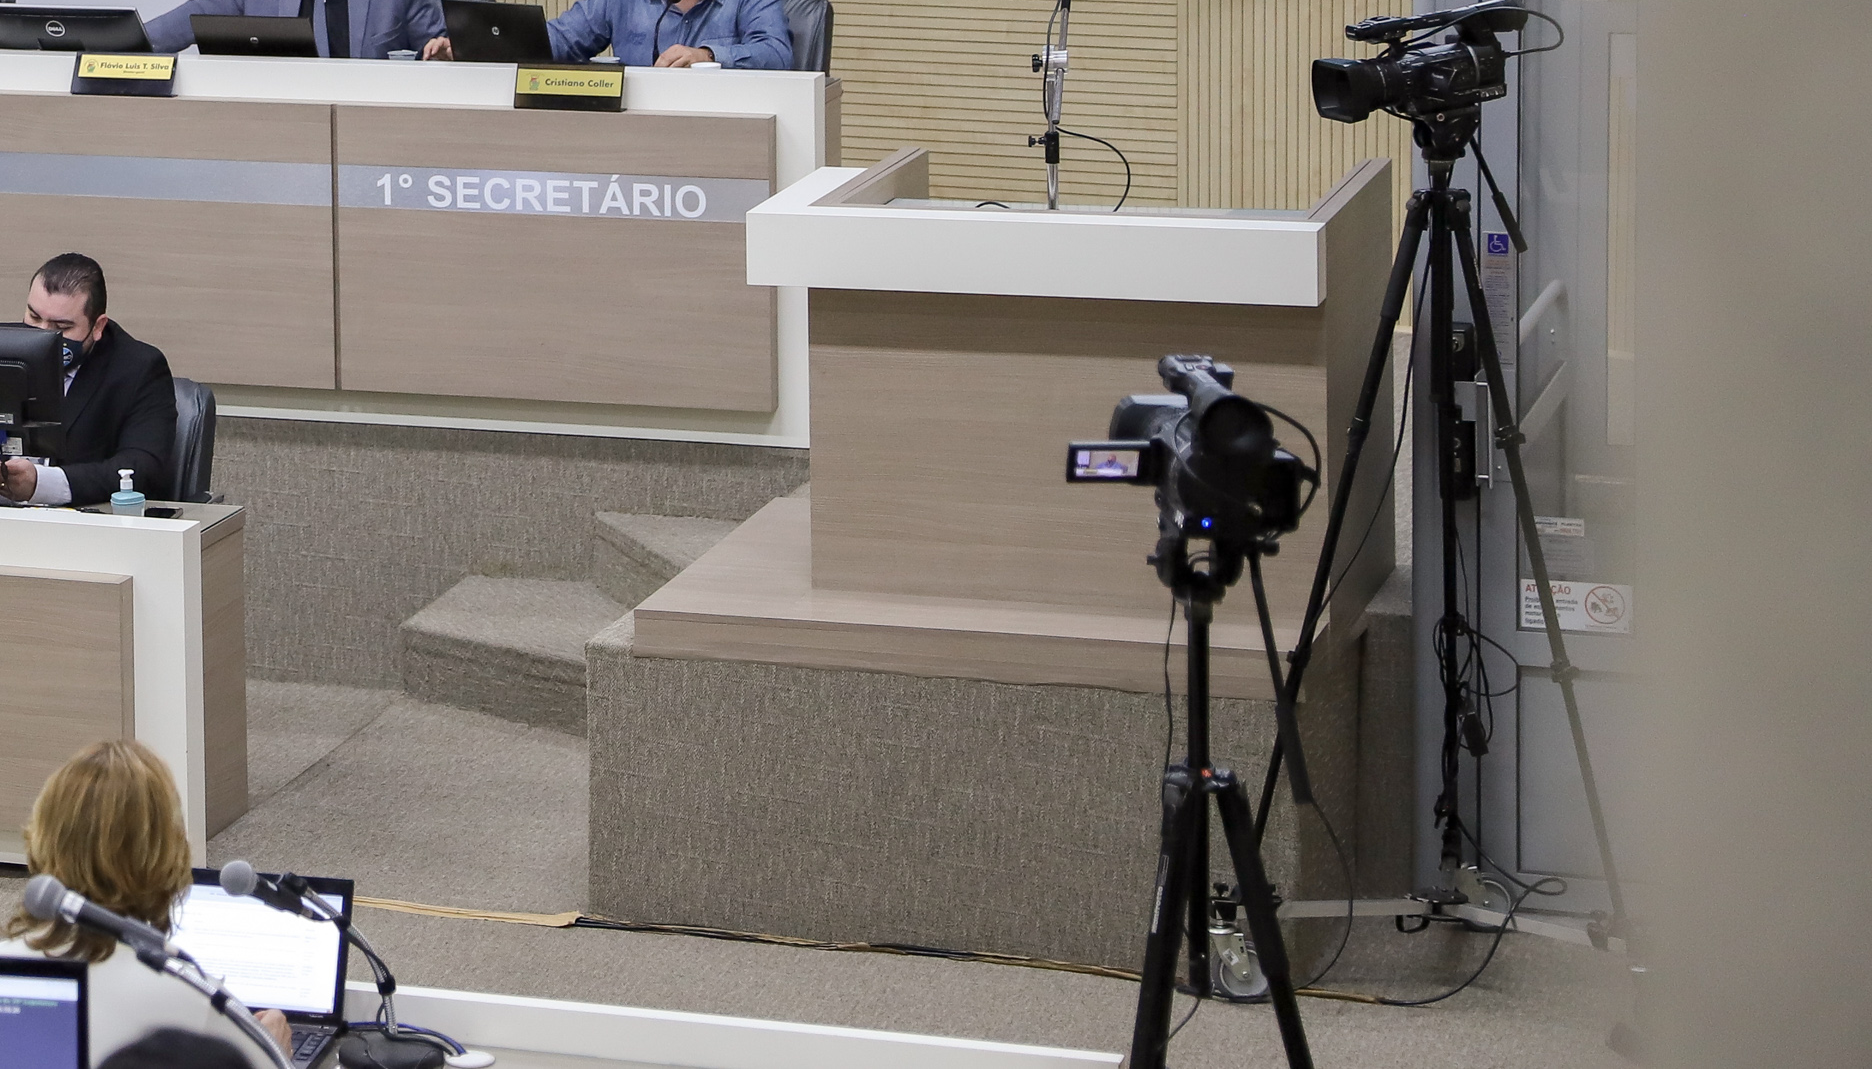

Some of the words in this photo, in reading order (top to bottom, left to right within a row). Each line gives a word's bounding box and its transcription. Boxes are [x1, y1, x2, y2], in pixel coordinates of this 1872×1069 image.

[125, 62, 140, 70] Luis
[545, 78, 585, 87] Cristiano
[587, 79, 614, 88] Coller
[427, 174, 707, 218] SECRETÁRIO
[1525, 584, 1571, 595] ATÇÃO
